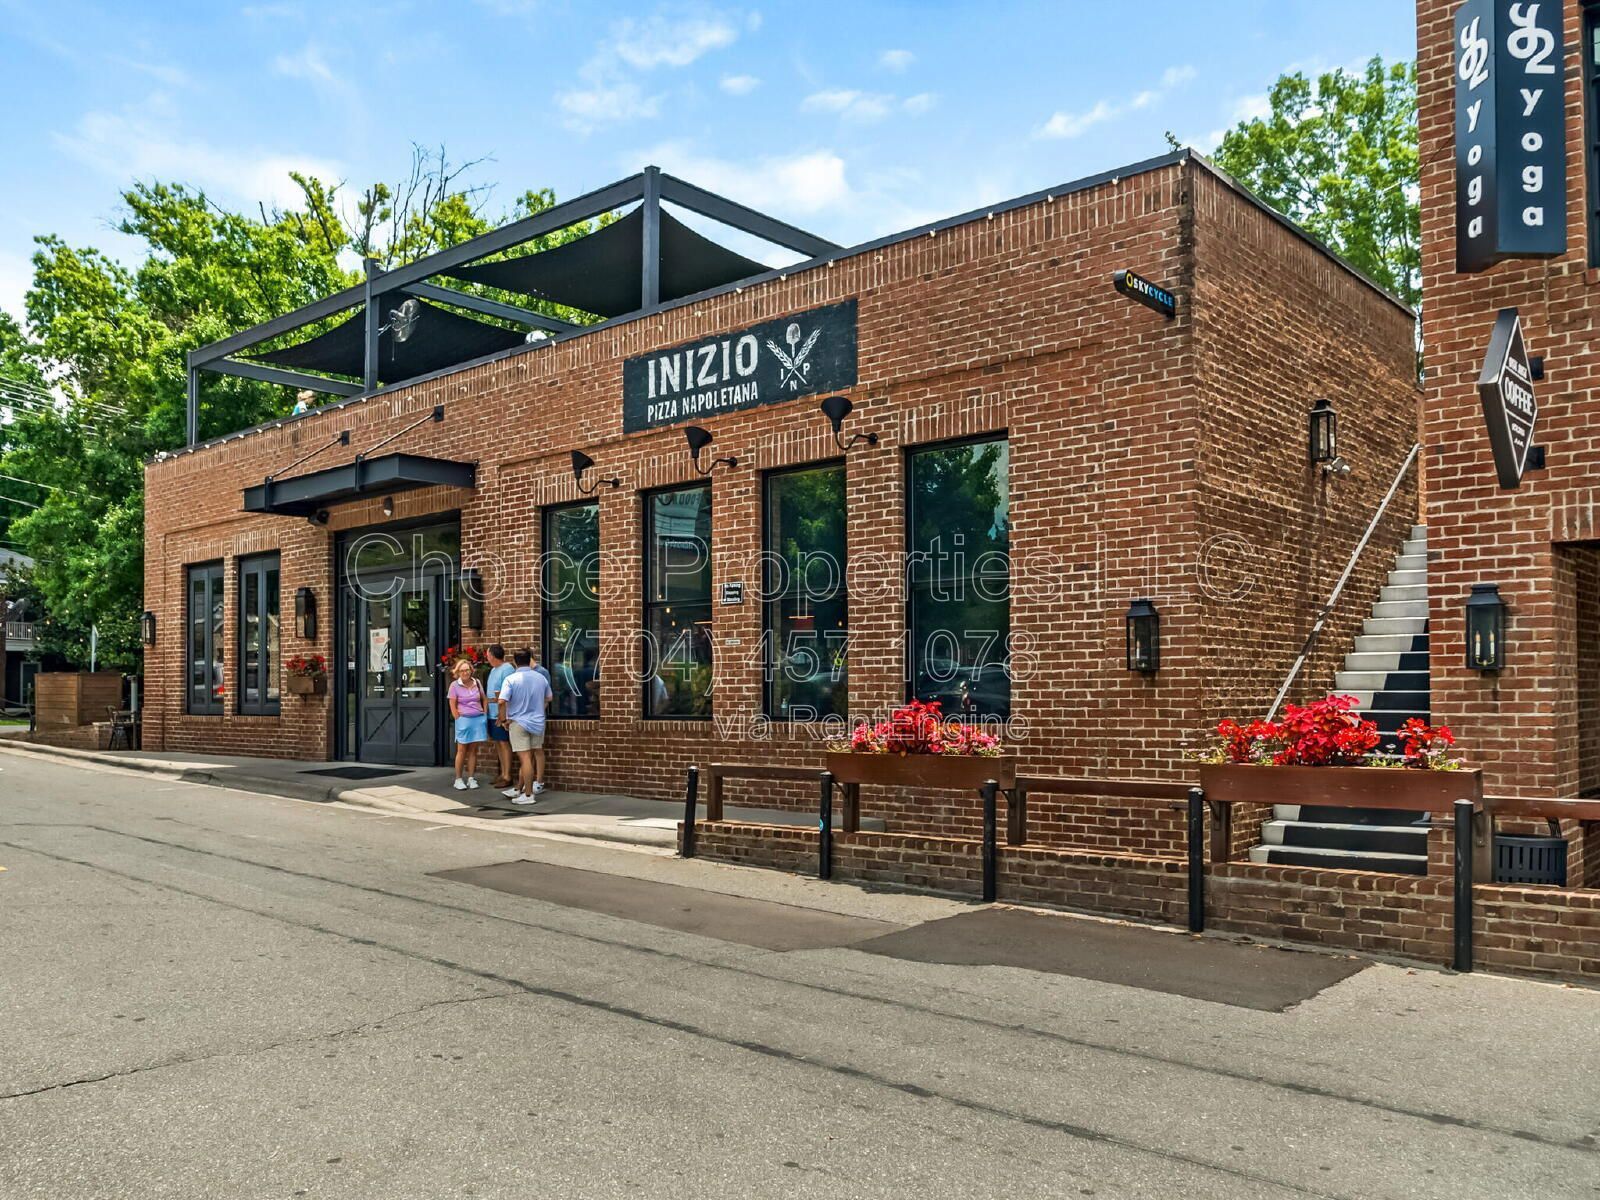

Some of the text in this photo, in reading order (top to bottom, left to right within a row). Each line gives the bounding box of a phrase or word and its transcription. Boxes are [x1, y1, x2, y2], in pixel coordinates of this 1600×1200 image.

[1466, 99, 1483, 239] yoga
[1519, 88, 1544, 226] yoga
[647, 334, 759, 398] INIZIO
[790, 379, 798, 392] N
[803, 362, 810, 376] P
[647, 381, 758, 423] PIZZA NAPOLETANA
[1504, 376, 1533, 417] COFFEE
